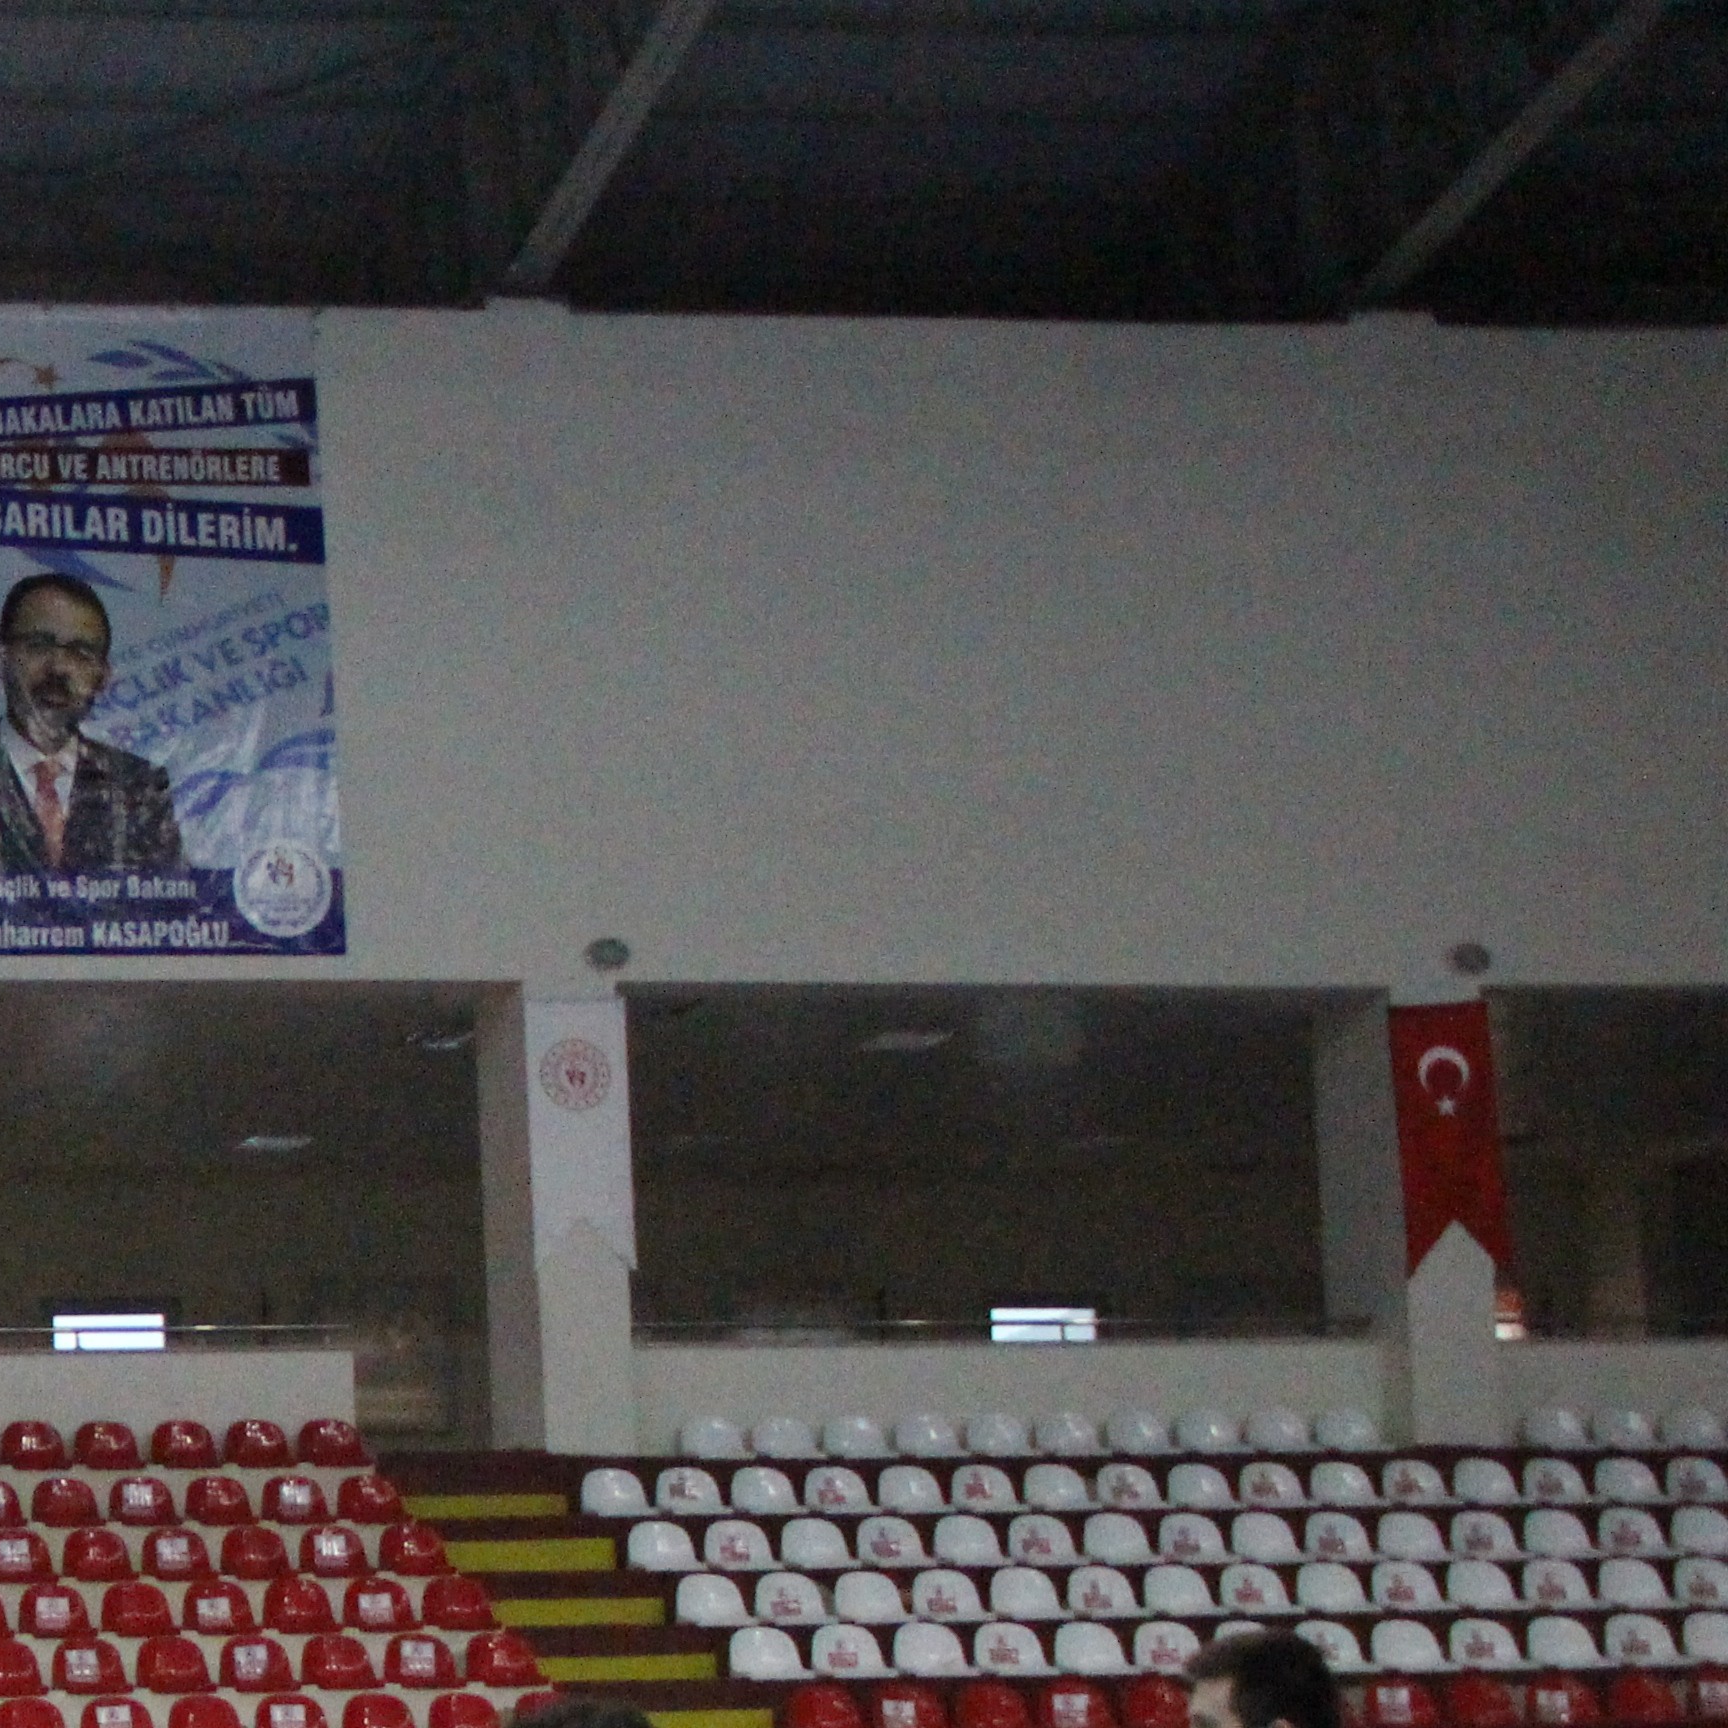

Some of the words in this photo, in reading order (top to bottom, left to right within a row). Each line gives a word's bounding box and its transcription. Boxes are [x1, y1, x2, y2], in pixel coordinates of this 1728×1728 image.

[129, 394, 234, 427] KATILAN
[242, 388, 299, 420] TÜM
[57, 452, 89, 481] VE
[96, 448, 280, 483] ANTRENÖRLERE
[142, 503, 299, 553] DİLERİM.
[48, 879, 71, 899] ve
[76, 875, 123, 905] Spor
[127, 875, 197, 899] Bakanı
[92, 914, 230, 948] KASAPOĞLU
